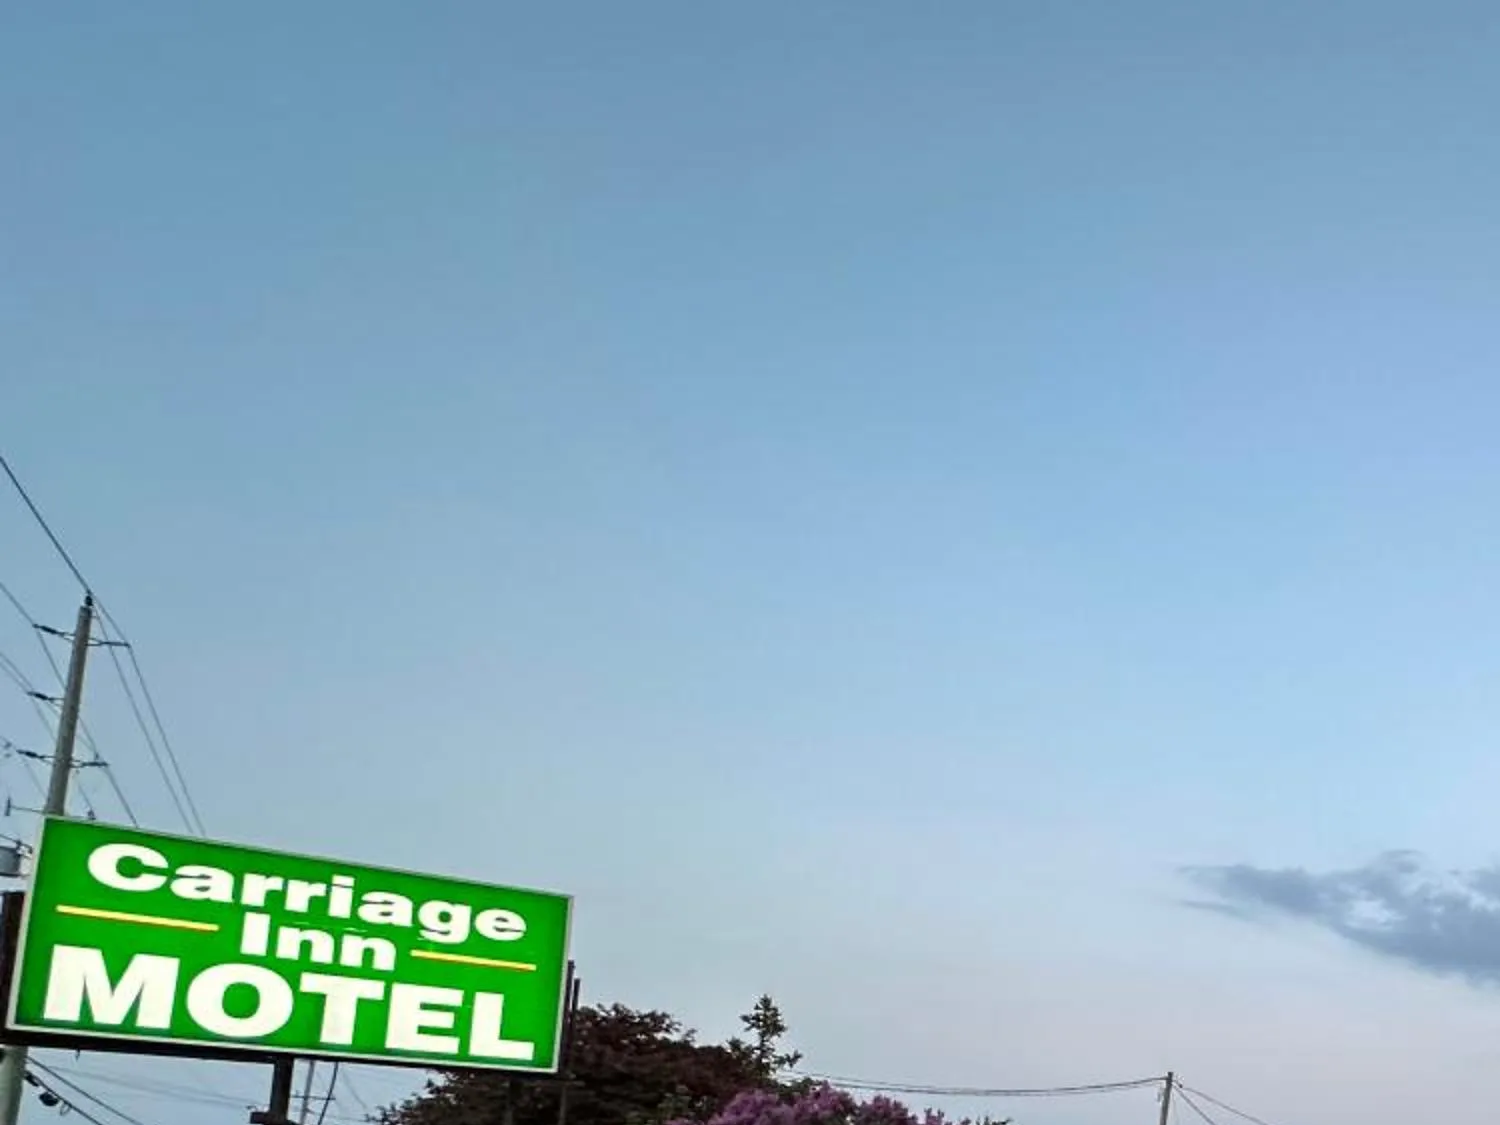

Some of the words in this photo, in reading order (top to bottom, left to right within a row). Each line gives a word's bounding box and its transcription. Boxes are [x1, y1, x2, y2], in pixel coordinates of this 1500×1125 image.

[88, 843, 527, 943] Carriage
[241, 912, 396, 971] Inn
[43, 944, 534, 1060] MOTEL
